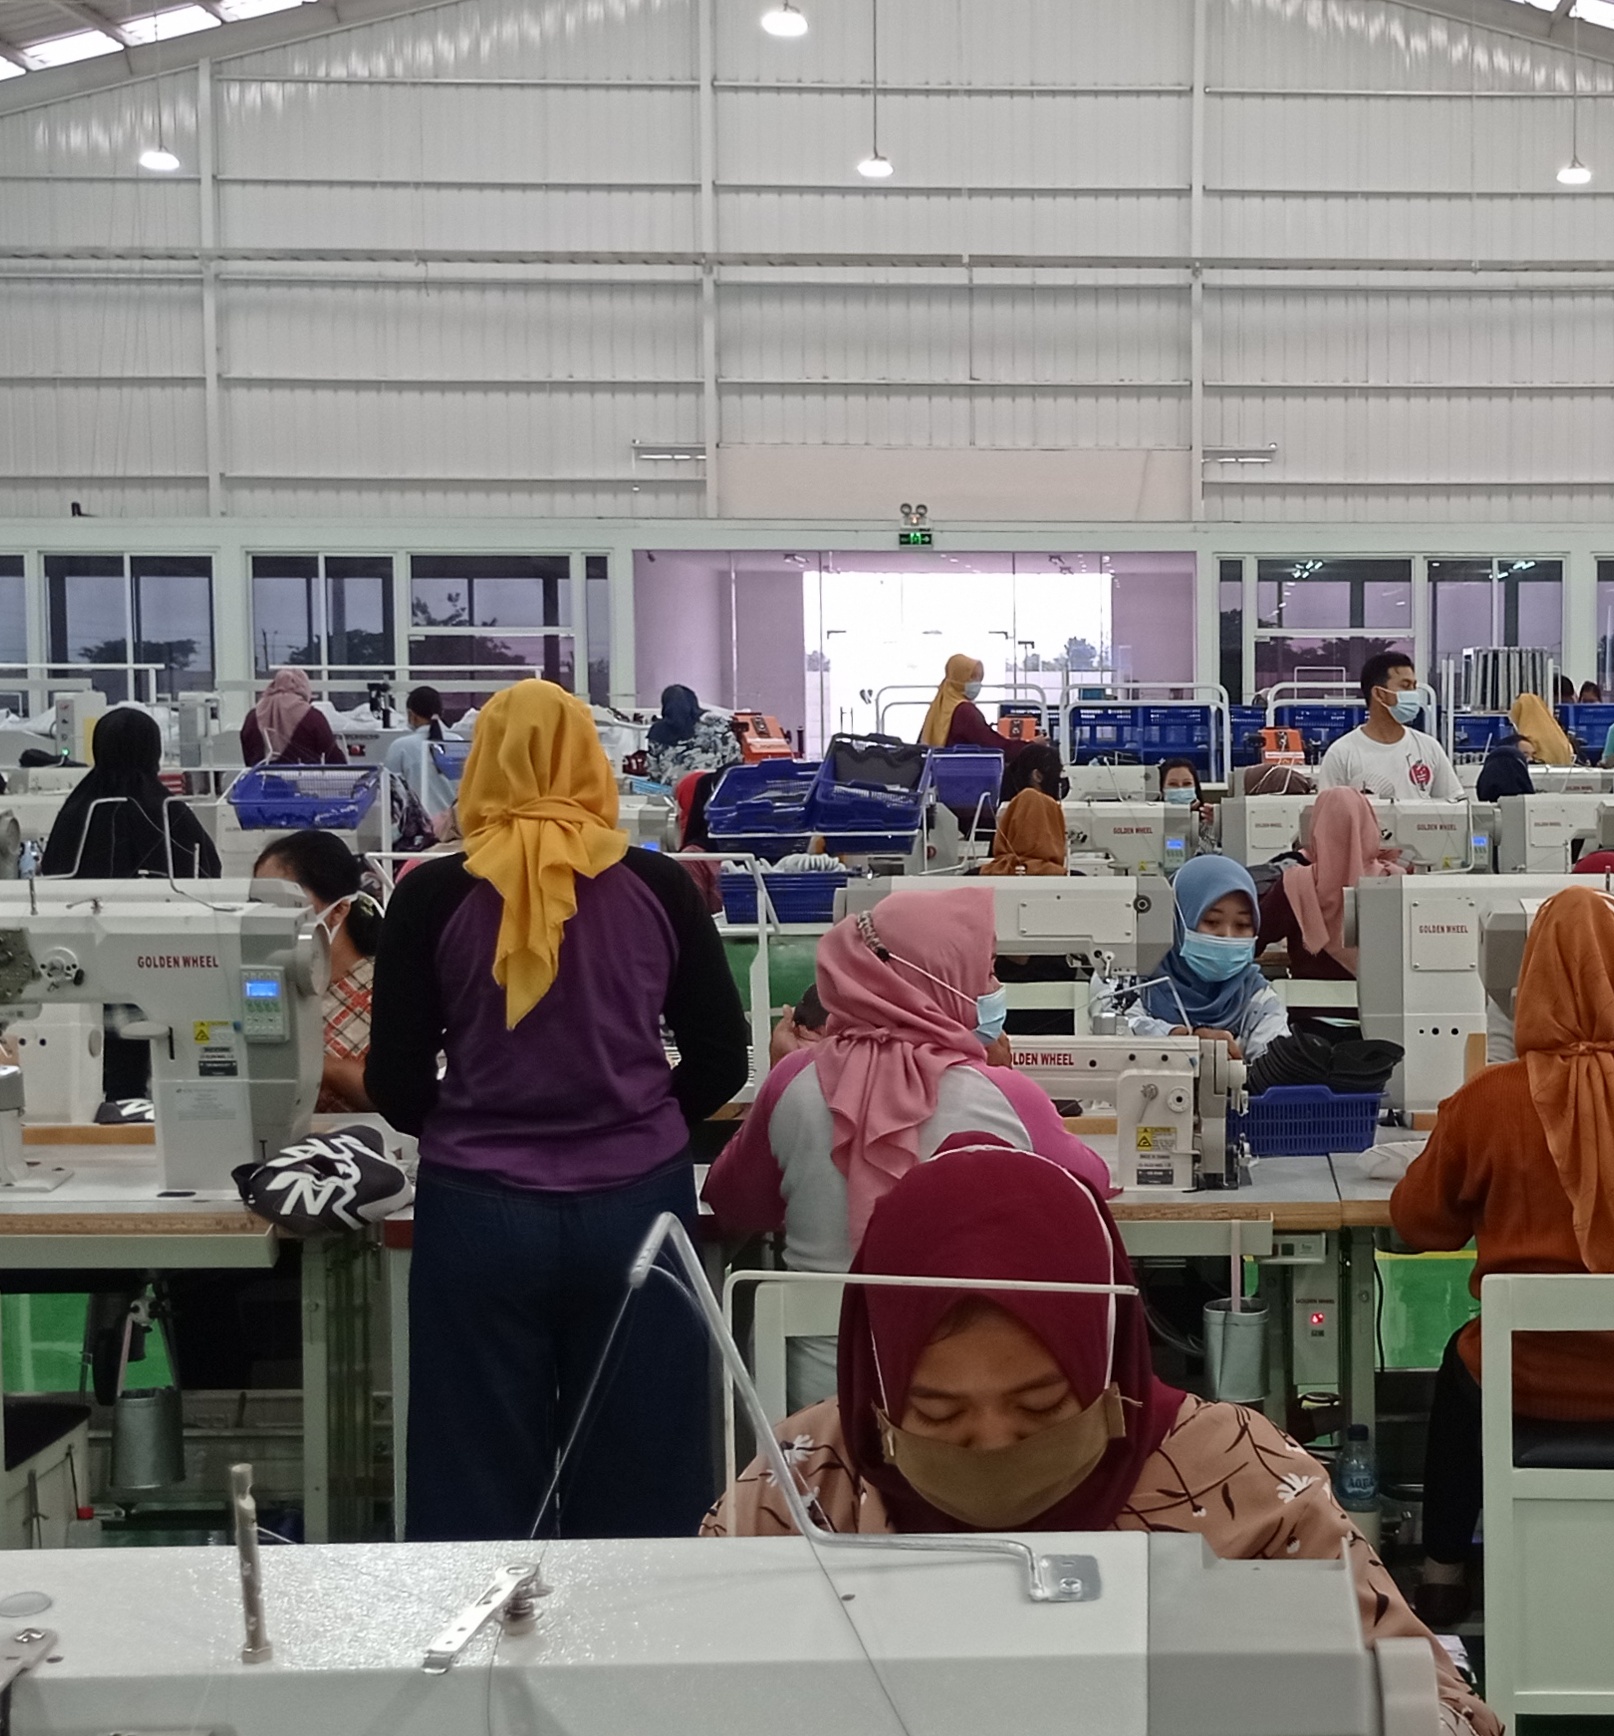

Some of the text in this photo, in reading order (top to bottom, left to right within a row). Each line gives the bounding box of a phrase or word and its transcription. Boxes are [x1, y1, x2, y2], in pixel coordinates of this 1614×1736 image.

[1419, 925, 1468, 933] GOLDEN WHEEL
[137, 956, 219, 968] GOLDEN WHEEL
[1011, 1053, 1075, 1066] LDEN WHEEL
